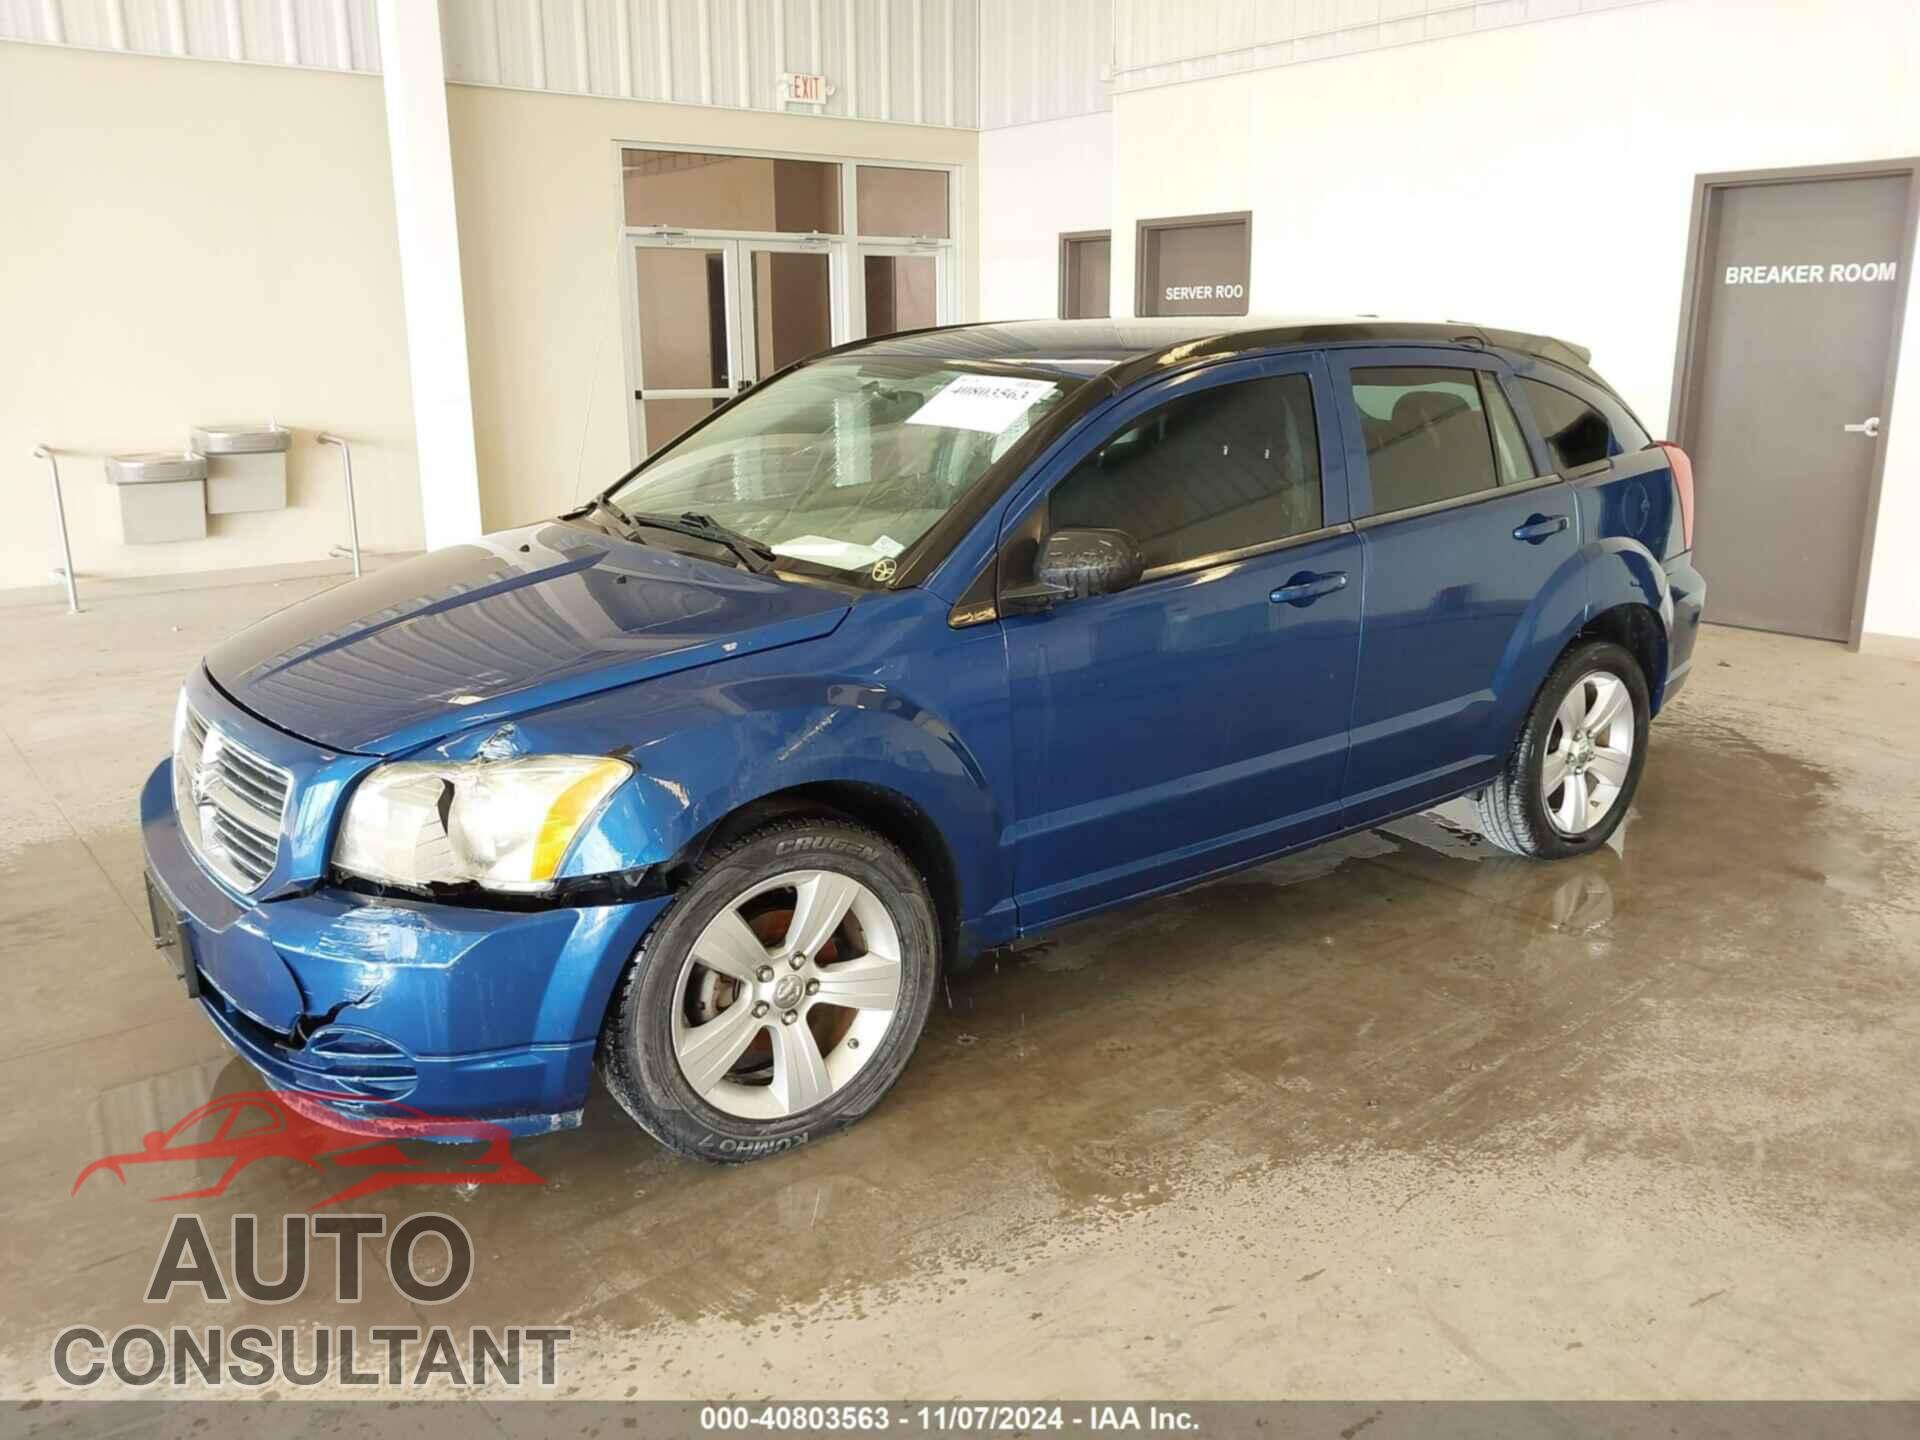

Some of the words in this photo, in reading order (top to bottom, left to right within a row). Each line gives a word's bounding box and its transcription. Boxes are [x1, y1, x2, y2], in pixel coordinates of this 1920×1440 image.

[794, 75, 820, 98] EXIT
[1725, 264, 1824, 284] BREAKER
[1829, 262, 1896, 282] ROOM
[1165, 285, 1213, 301] SERVER
[1215, 284, 1243, 299] ROO
